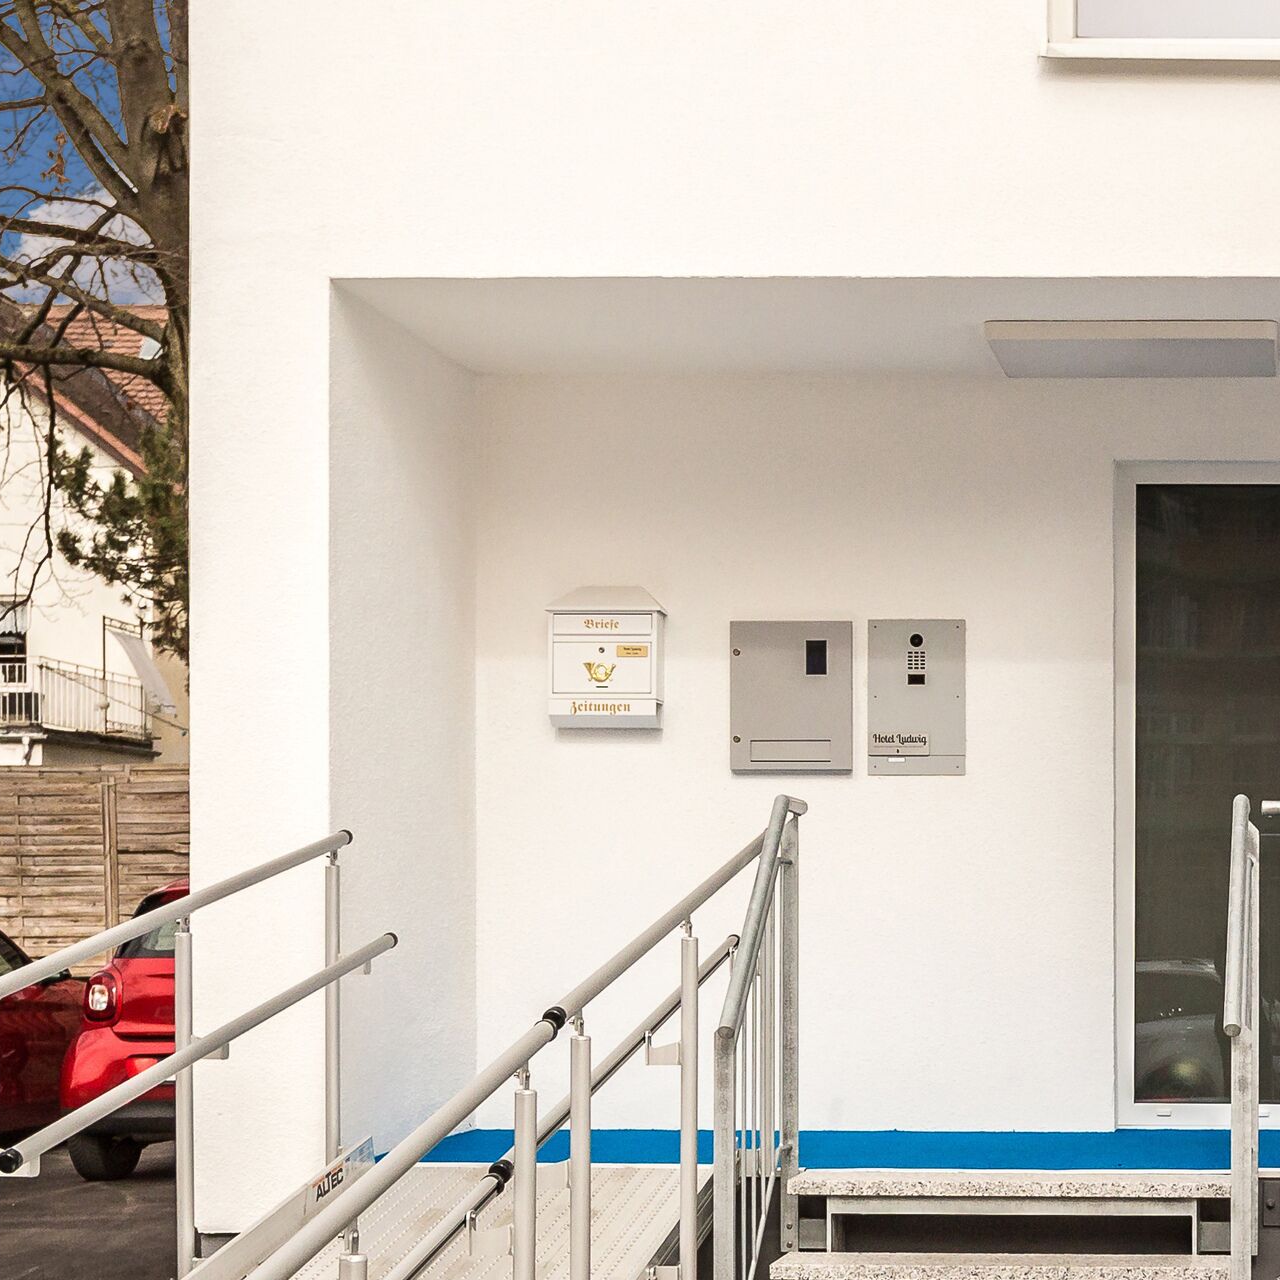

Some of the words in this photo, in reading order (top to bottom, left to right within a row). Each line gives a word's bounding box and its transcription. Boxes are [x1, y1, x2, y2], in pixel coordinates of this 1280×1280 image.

[583, 619, 619, 630] Briefe
[570, 701, 631, 715] Zeitungen
[873, 734, 895, 743] Hotel
[896, 734, 927, 745] Ludwig
